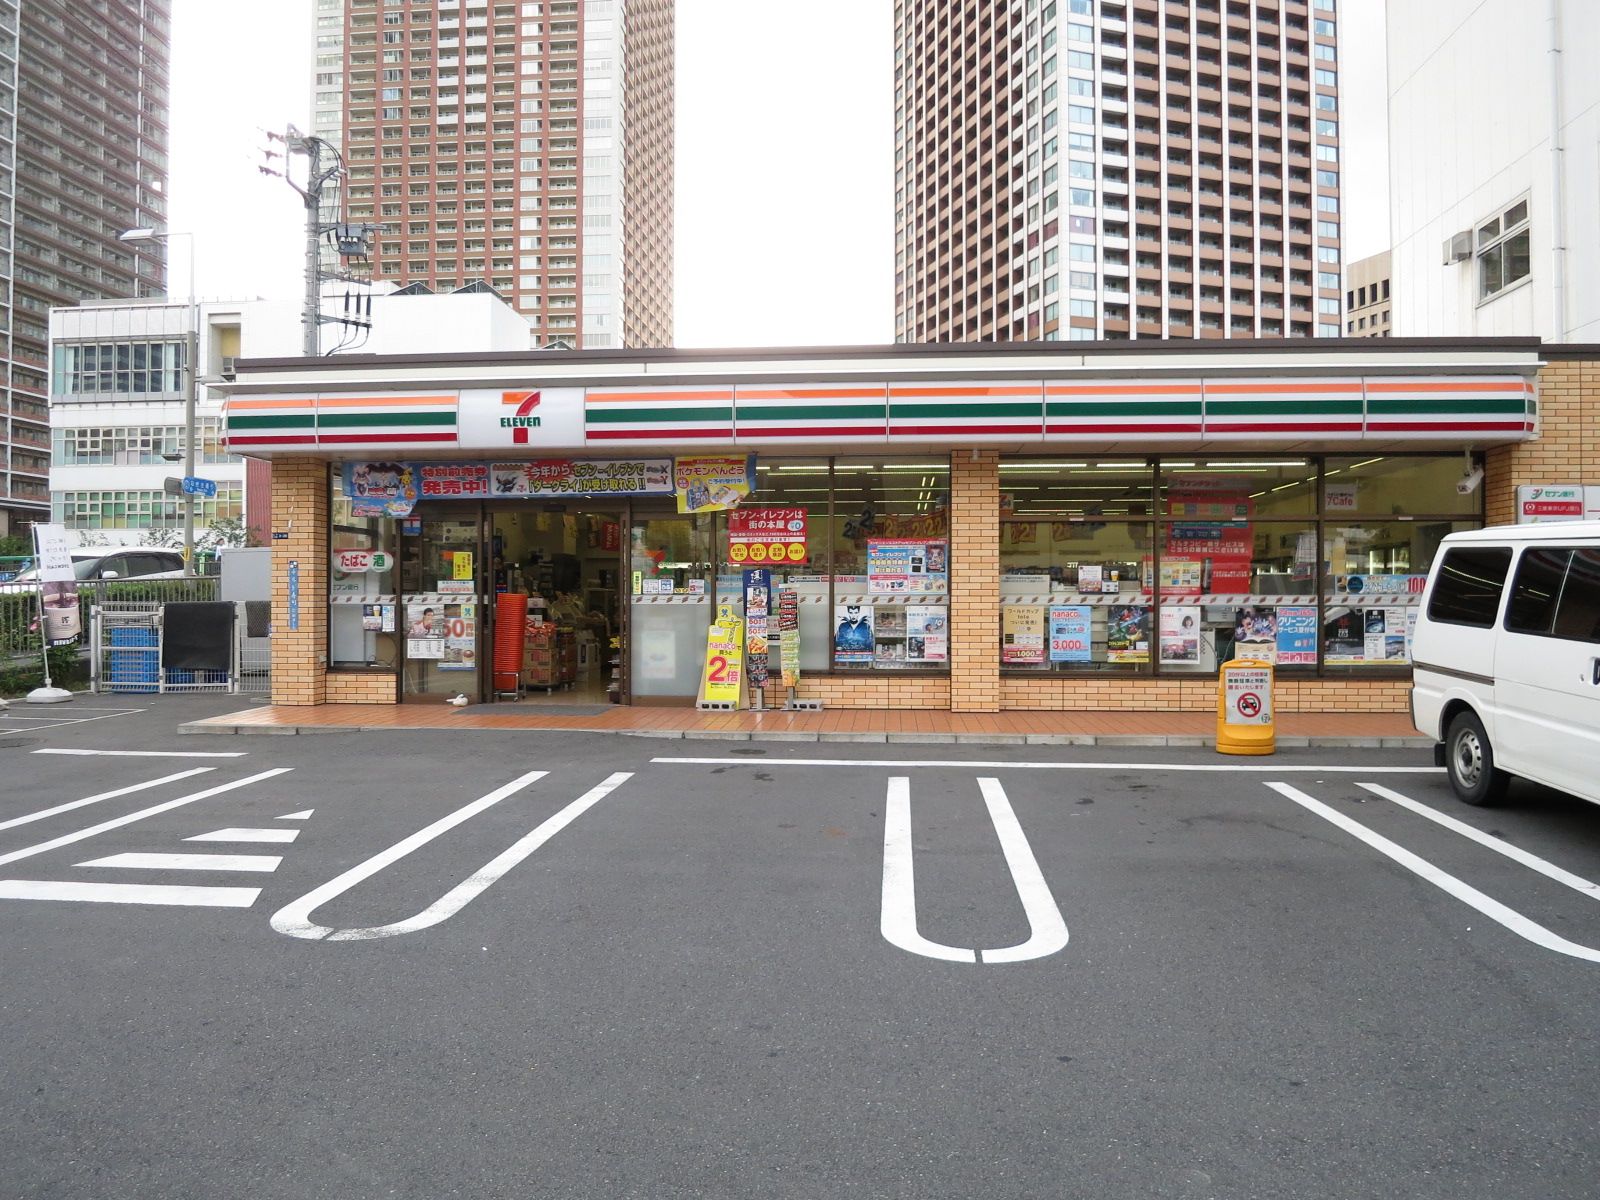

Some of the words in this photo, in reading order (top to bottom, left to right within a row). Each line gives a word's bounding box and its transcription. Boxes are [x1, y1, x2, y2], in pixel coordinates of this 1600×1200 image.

[530, 463, 571, 478] 今年から
[422, 479, 488, 495] 発売中!
[731, 510, 803, 520] セブン-イレブンは
[748, 520, 785, 529] 街の本屋
[340, 554, 368, 567] たばこ
[373, 554, 385, 567] 酒
[1278, 617, 1316, 626] クリーニング
